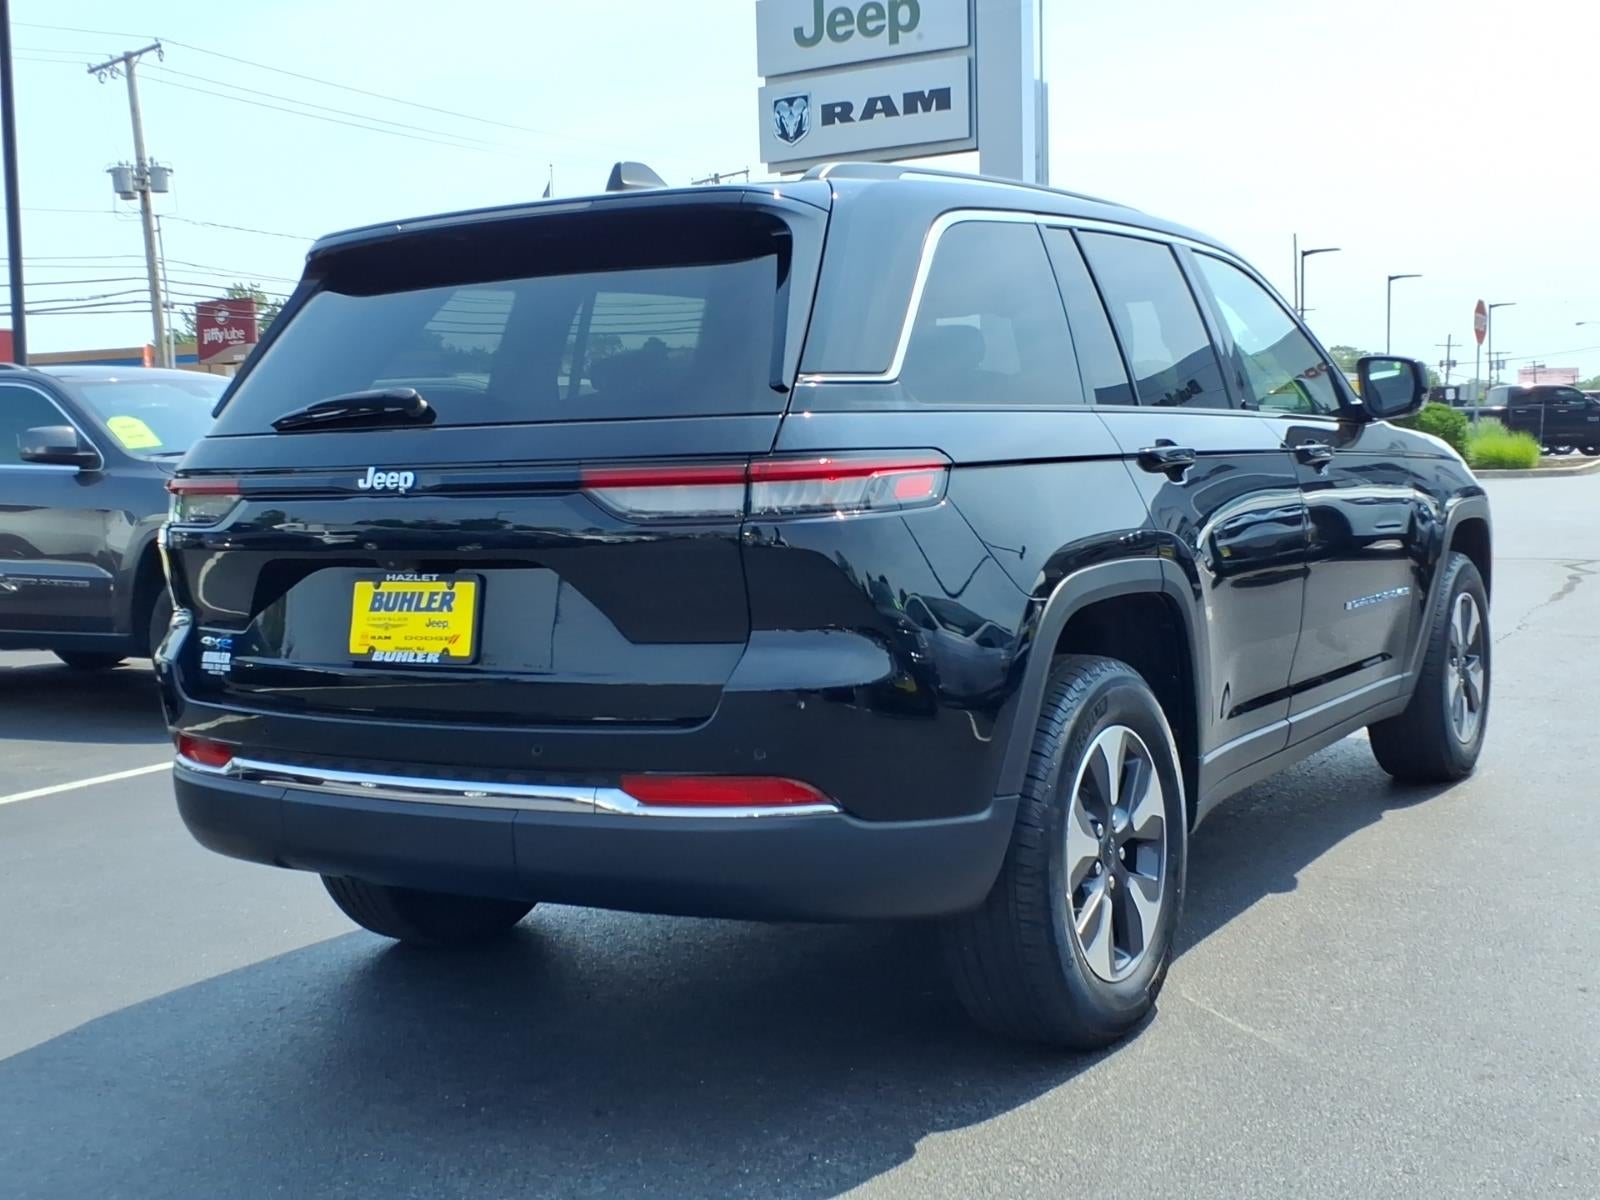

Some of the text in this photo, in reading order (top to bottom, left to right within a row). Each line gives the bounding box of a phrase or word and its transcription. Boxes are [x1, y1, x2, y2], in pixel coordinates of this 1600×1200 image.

[793, 0, 921, 48] Jeep
[821, 86, 952, 127] RAM
[358, 466, 415, 494] Jeep
[385, 574, 440, 582] HAZLET
[369, 591, 456, 612] BUHLER
[425, 618, 449, 629] Jeep
[371, 651, 441, 663] BUHLER
